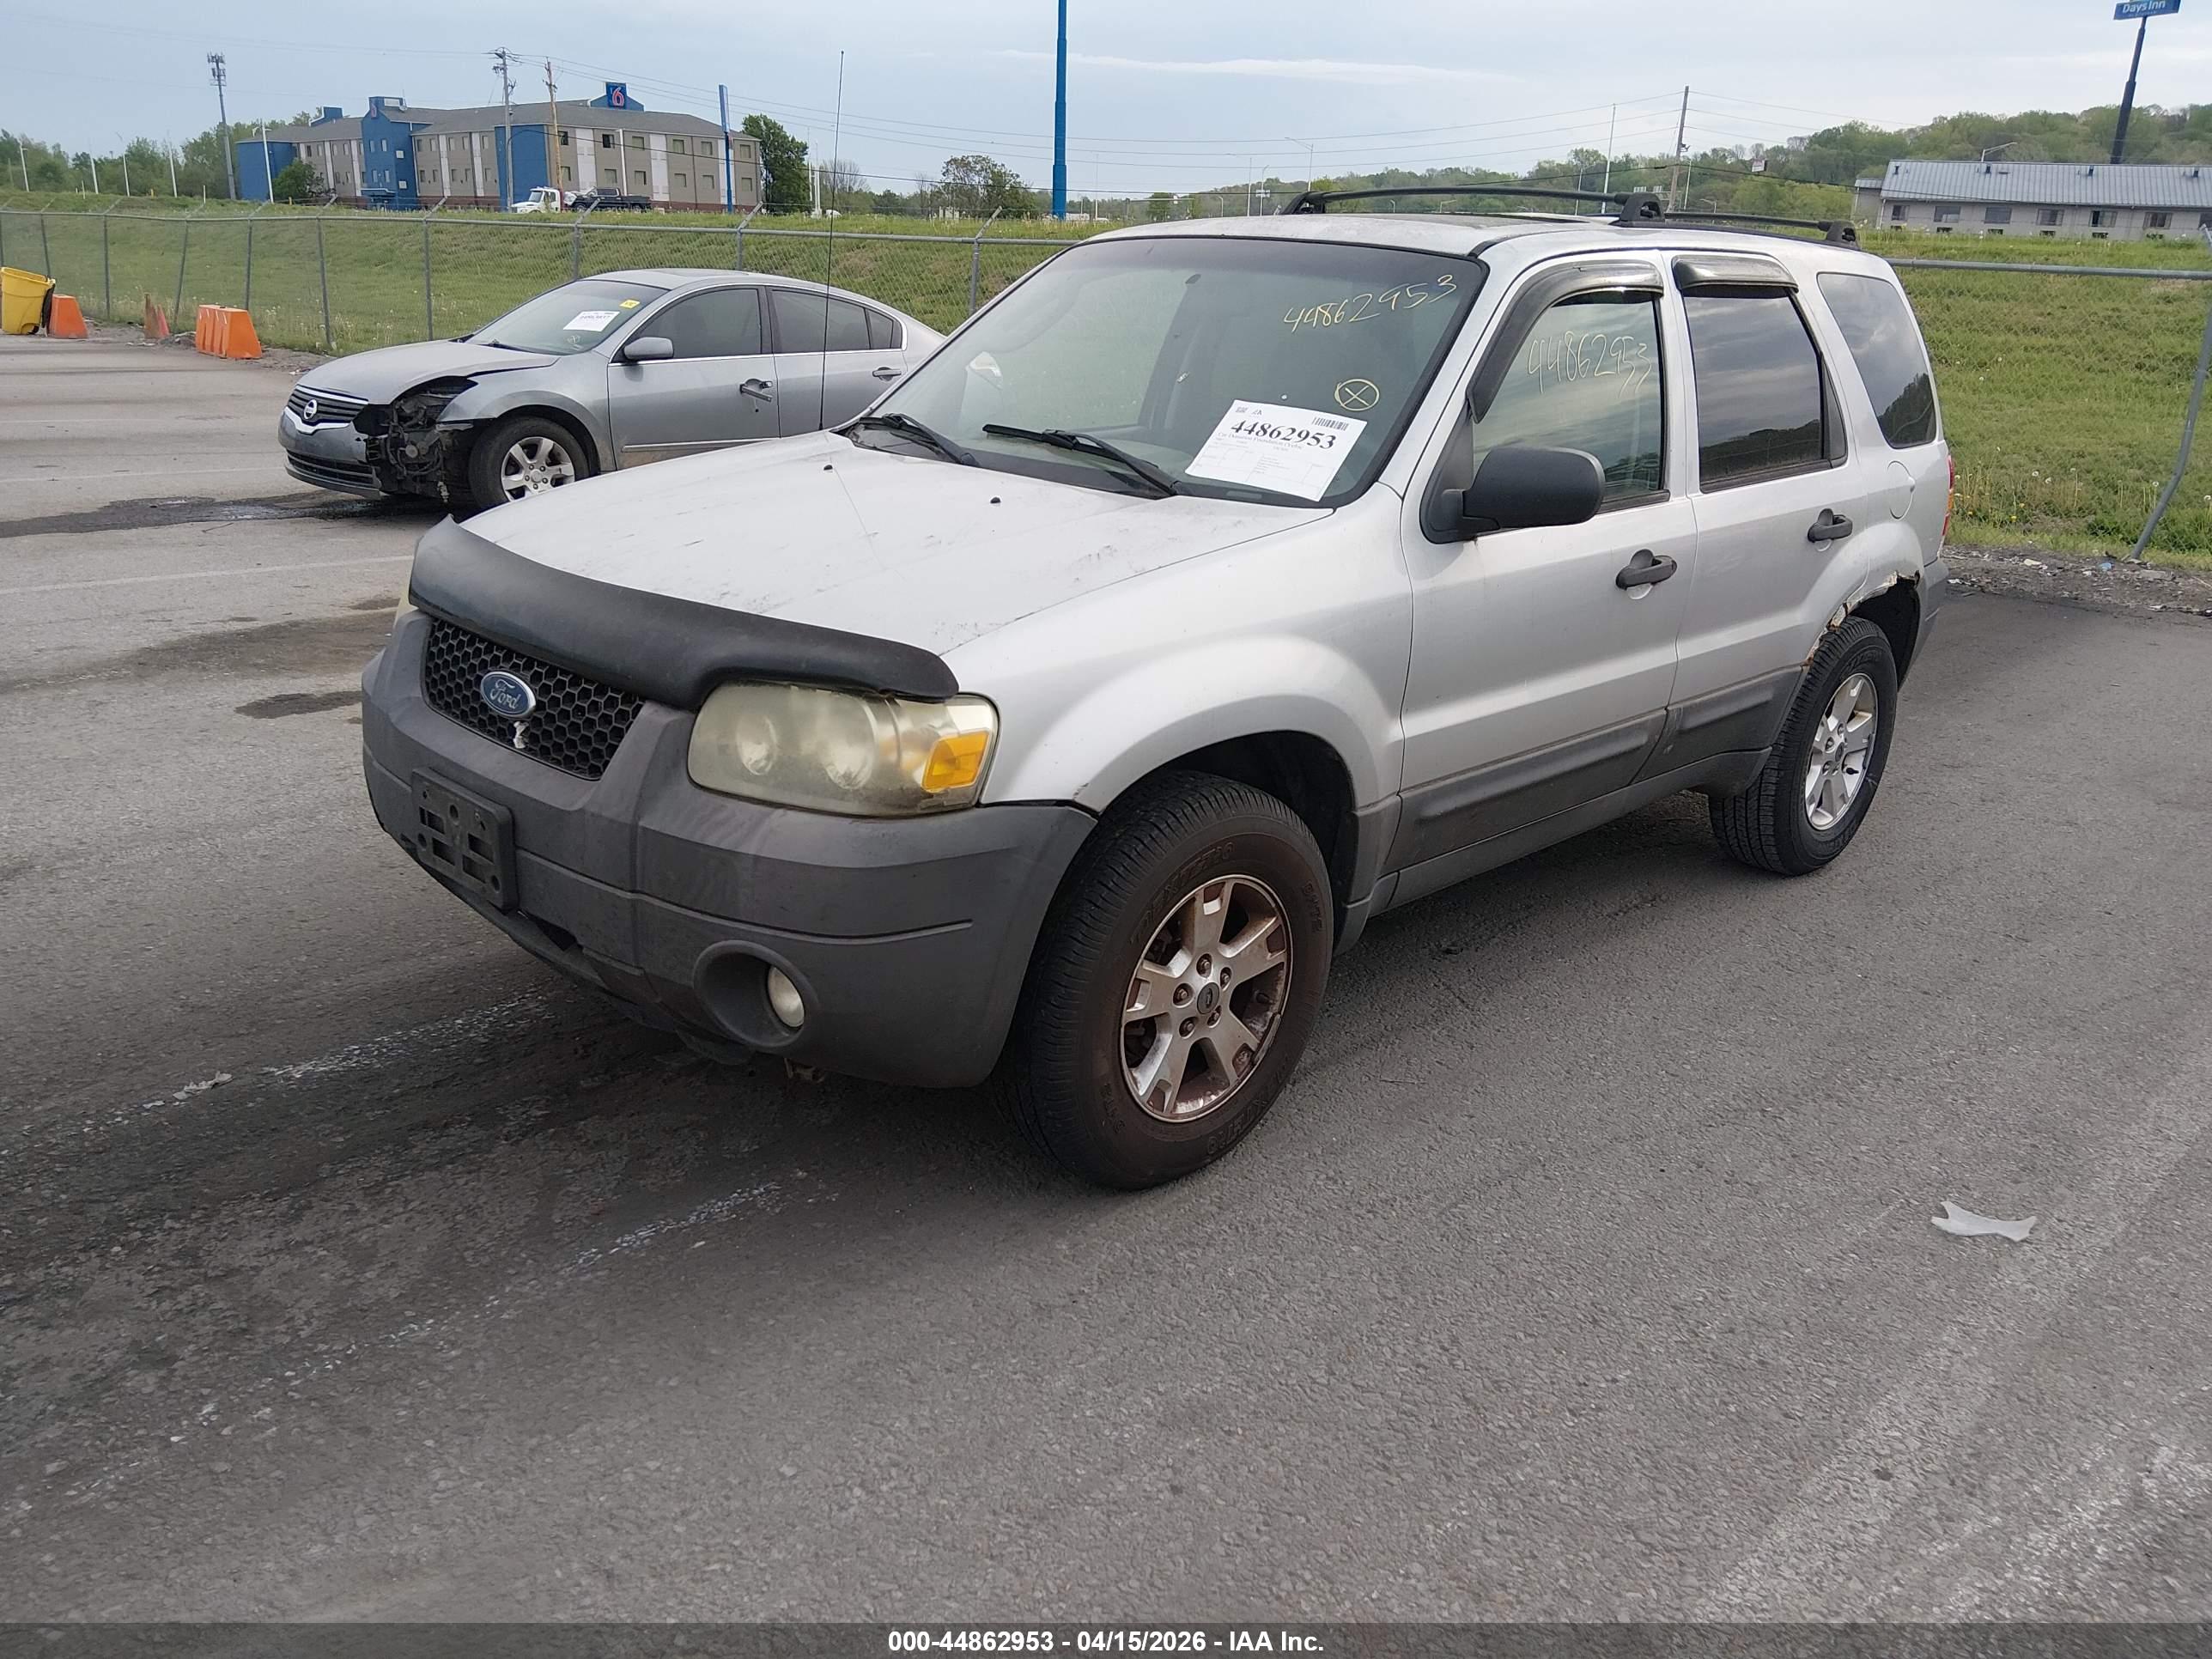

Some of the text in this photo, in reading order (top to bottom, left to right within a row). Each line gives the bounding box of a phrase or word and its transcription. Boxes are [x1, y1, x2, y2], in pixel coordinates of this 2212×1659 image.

[2123, 3, 2147, 14] Days
[2148, 0, 2166, 9] Inn
[612, 87, 624, 106] 6
[1231, 420, 1337, 450] 44862953
[490, 678, 522, 709] Ford
